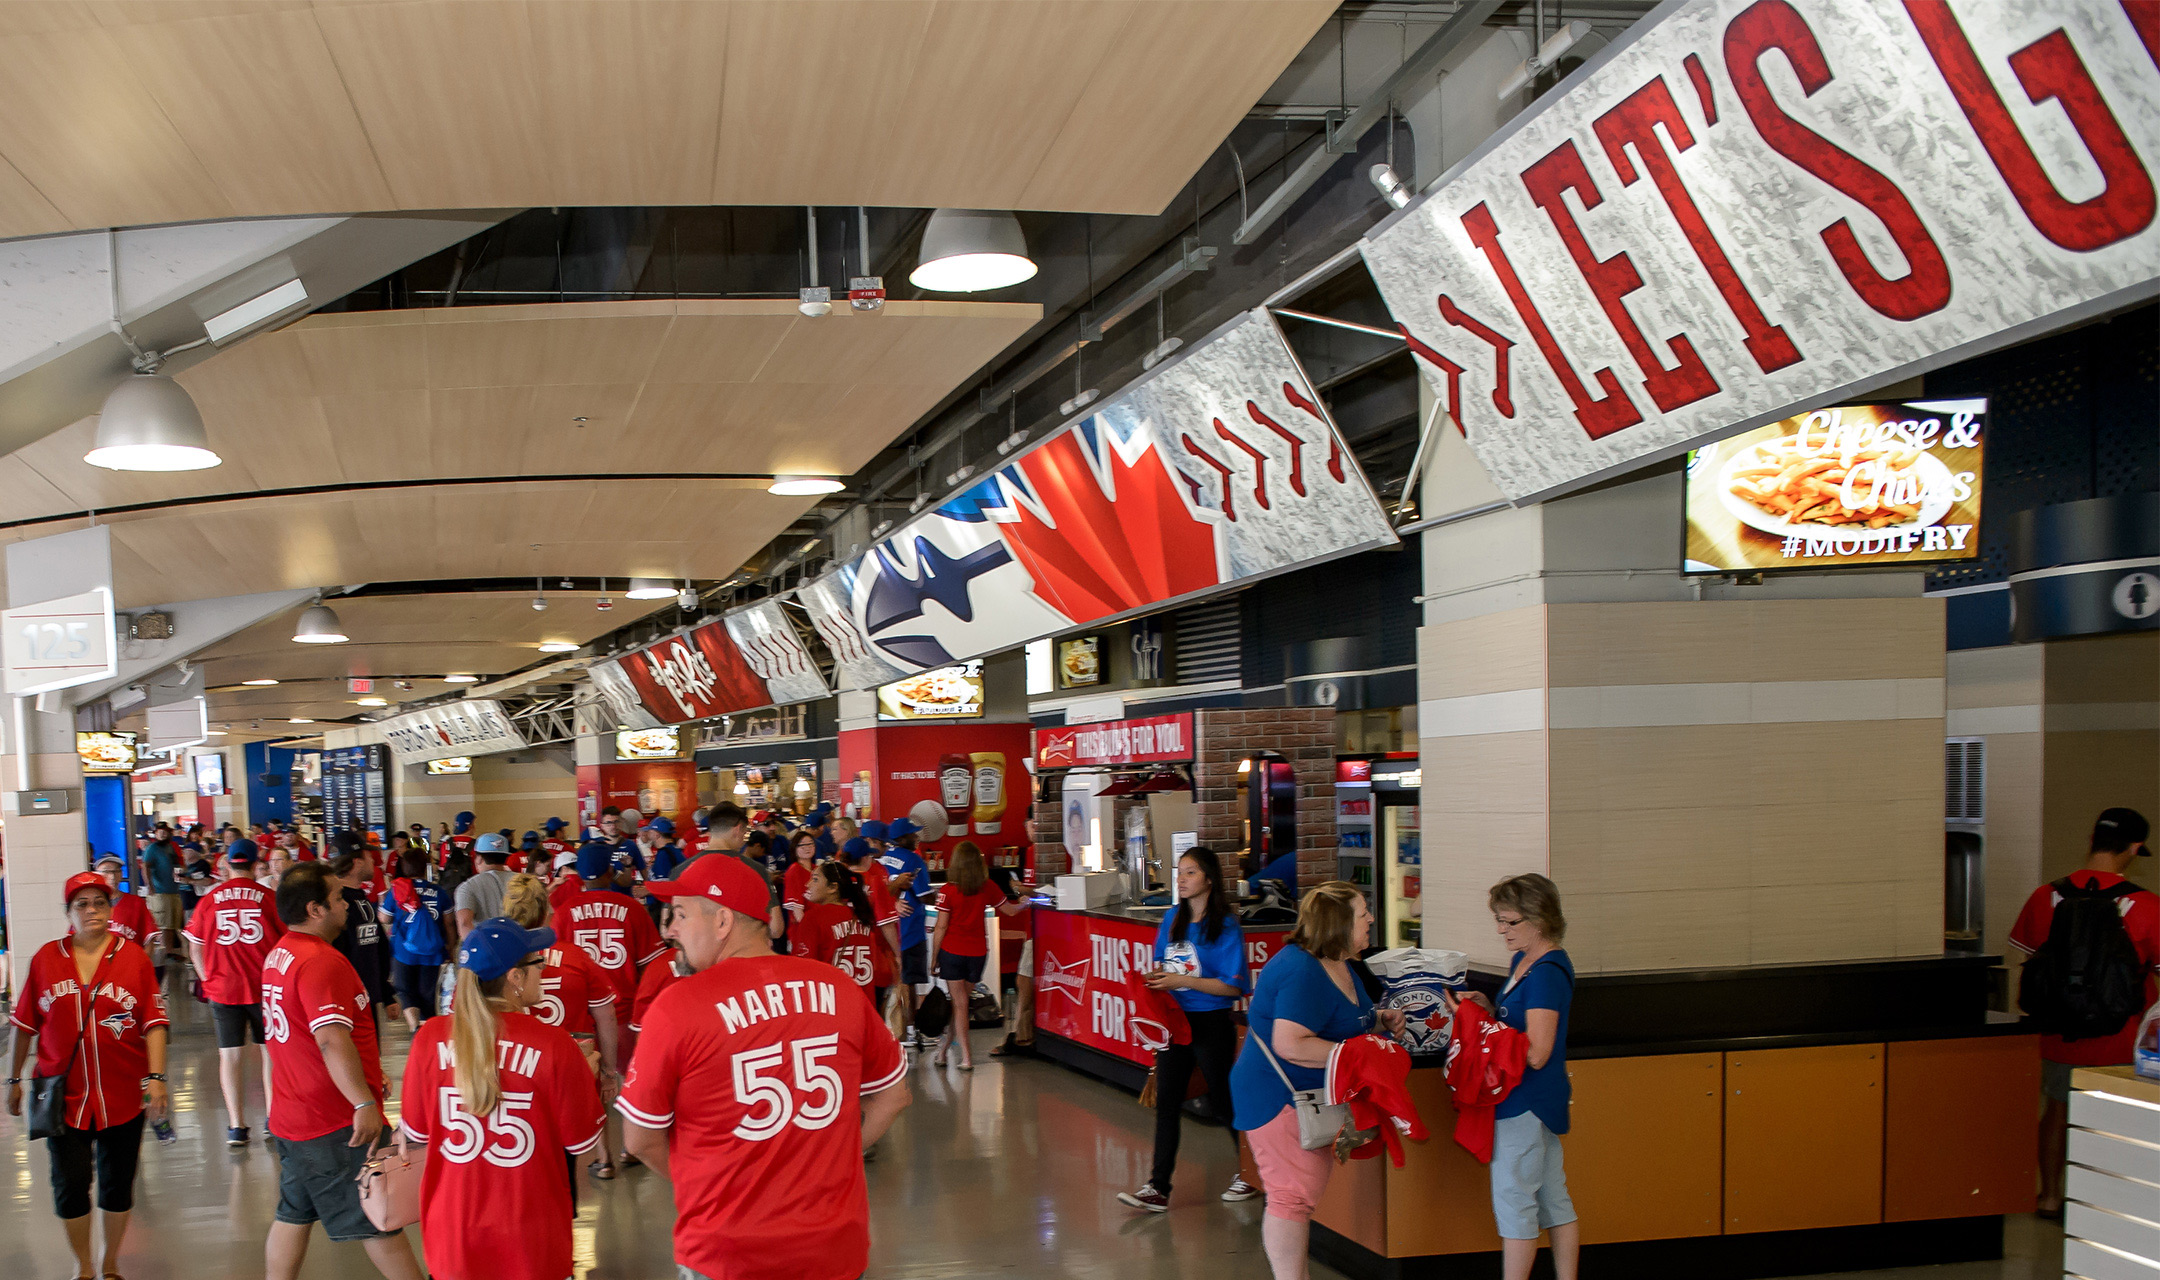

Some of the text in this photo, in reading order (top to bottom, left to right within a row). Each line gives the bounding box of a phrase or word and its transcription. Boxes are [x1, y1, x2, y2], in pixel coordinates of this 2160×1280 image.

[1460, 0, 2159, 442] LET'S G
[1797, 409, 1981, 459] Cheese &
[1780, 525, 1974, 558] #MODIFRY
[22, 622, 91, 660] 125
[1074, 731, 1098, 758] THIS
[1131, 725, 1155, 755] FOR
[213, 887, 264, 904] MARTIN
[571, 903, 629, 922] MARTIN
[215, 908, 264, 946] 55
[573, 929, 628, 969] 55
[1090, 934, 1130, 984] THIS
[38, 978, 80, 1012] BLUE
[262, 984, 290, 1044] 55
[715, 980, 836, 1035] MARTIN
[1092, 990, 1127, 1042] FOR
[437, 1040, 542, 1079] MTIN
[731, 1032, 844, 1141] 55
[439, 1087, 536, 1168] 55
